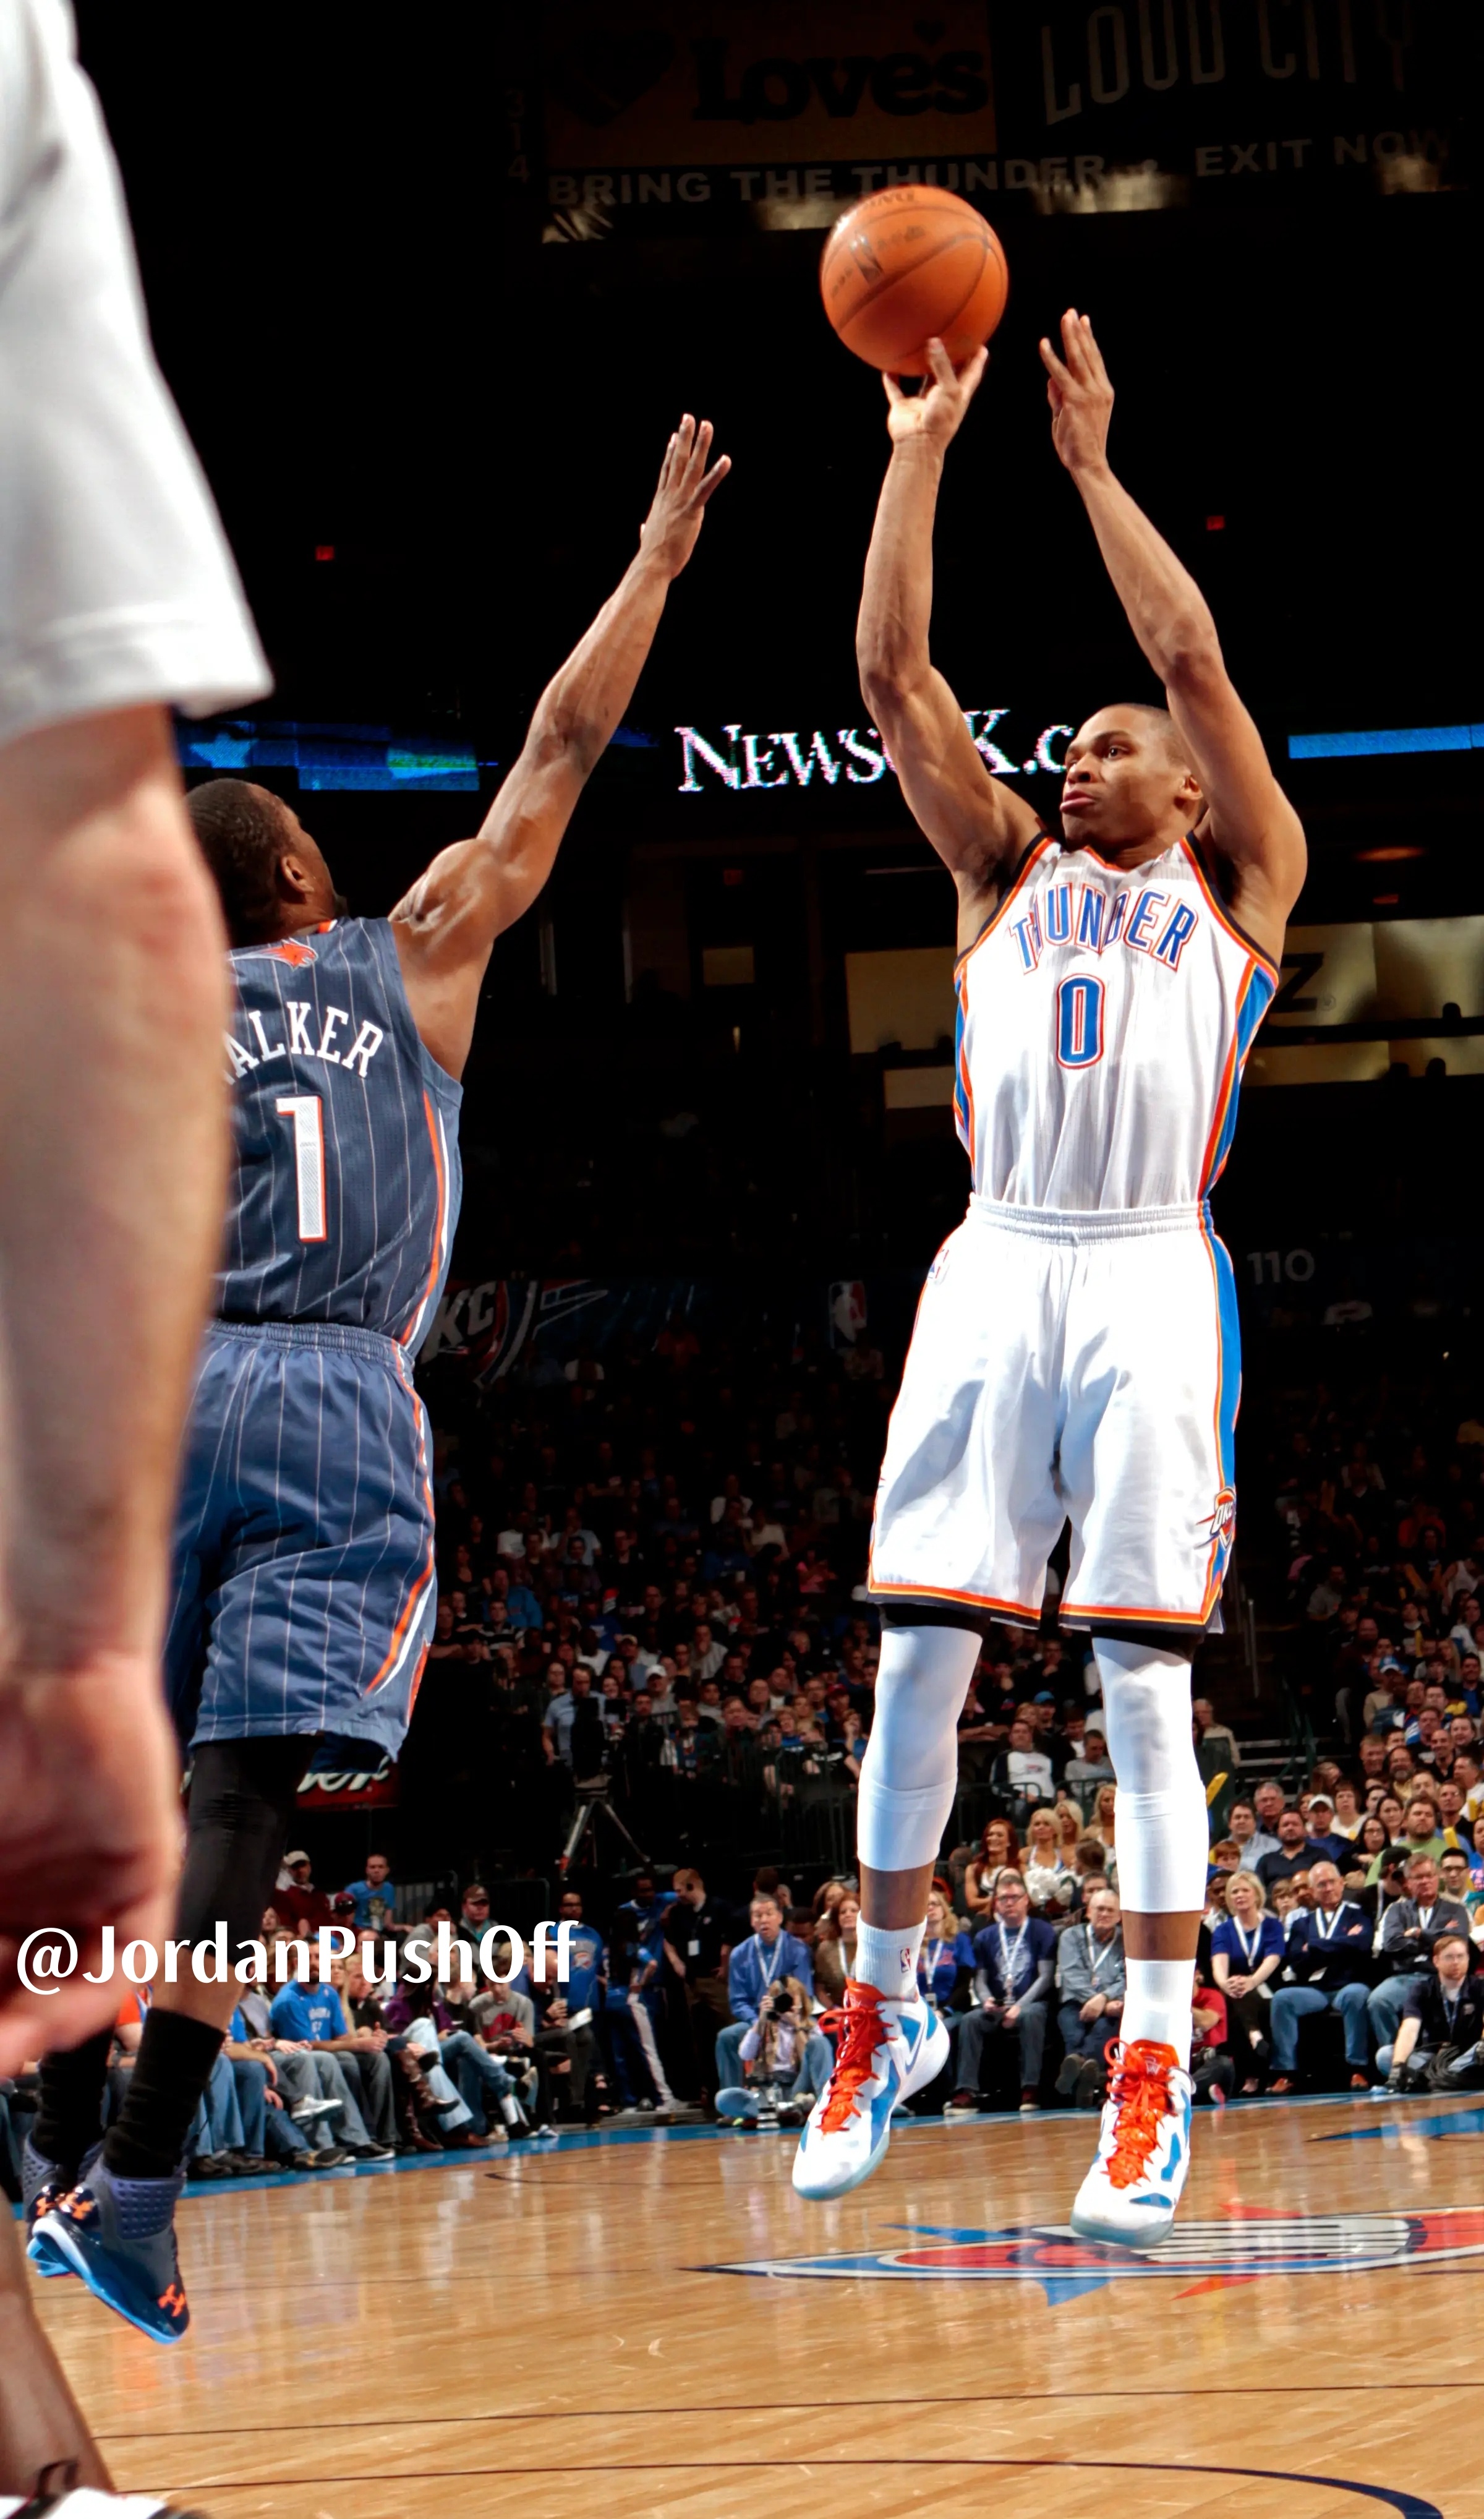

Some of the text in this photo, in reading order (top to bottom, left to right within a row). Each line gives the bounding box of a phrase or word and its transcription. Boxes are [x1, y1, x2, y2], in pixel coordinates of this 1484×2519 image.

[1040, 0, 1226, 126] LOUD
[547, 172, 712, 207] BRING
[730, 168, 835, 202] THE
[1195, 137, 1313, 178] EXIT
[221, 1001, 383, 1086] ALKER
[1056, 973, 1105, 1070] 0
[275, 1093, 328, 1243] 1
[1247, 1248, 1316, 1286] 110
[419, 1280, 496, 1364] KC
